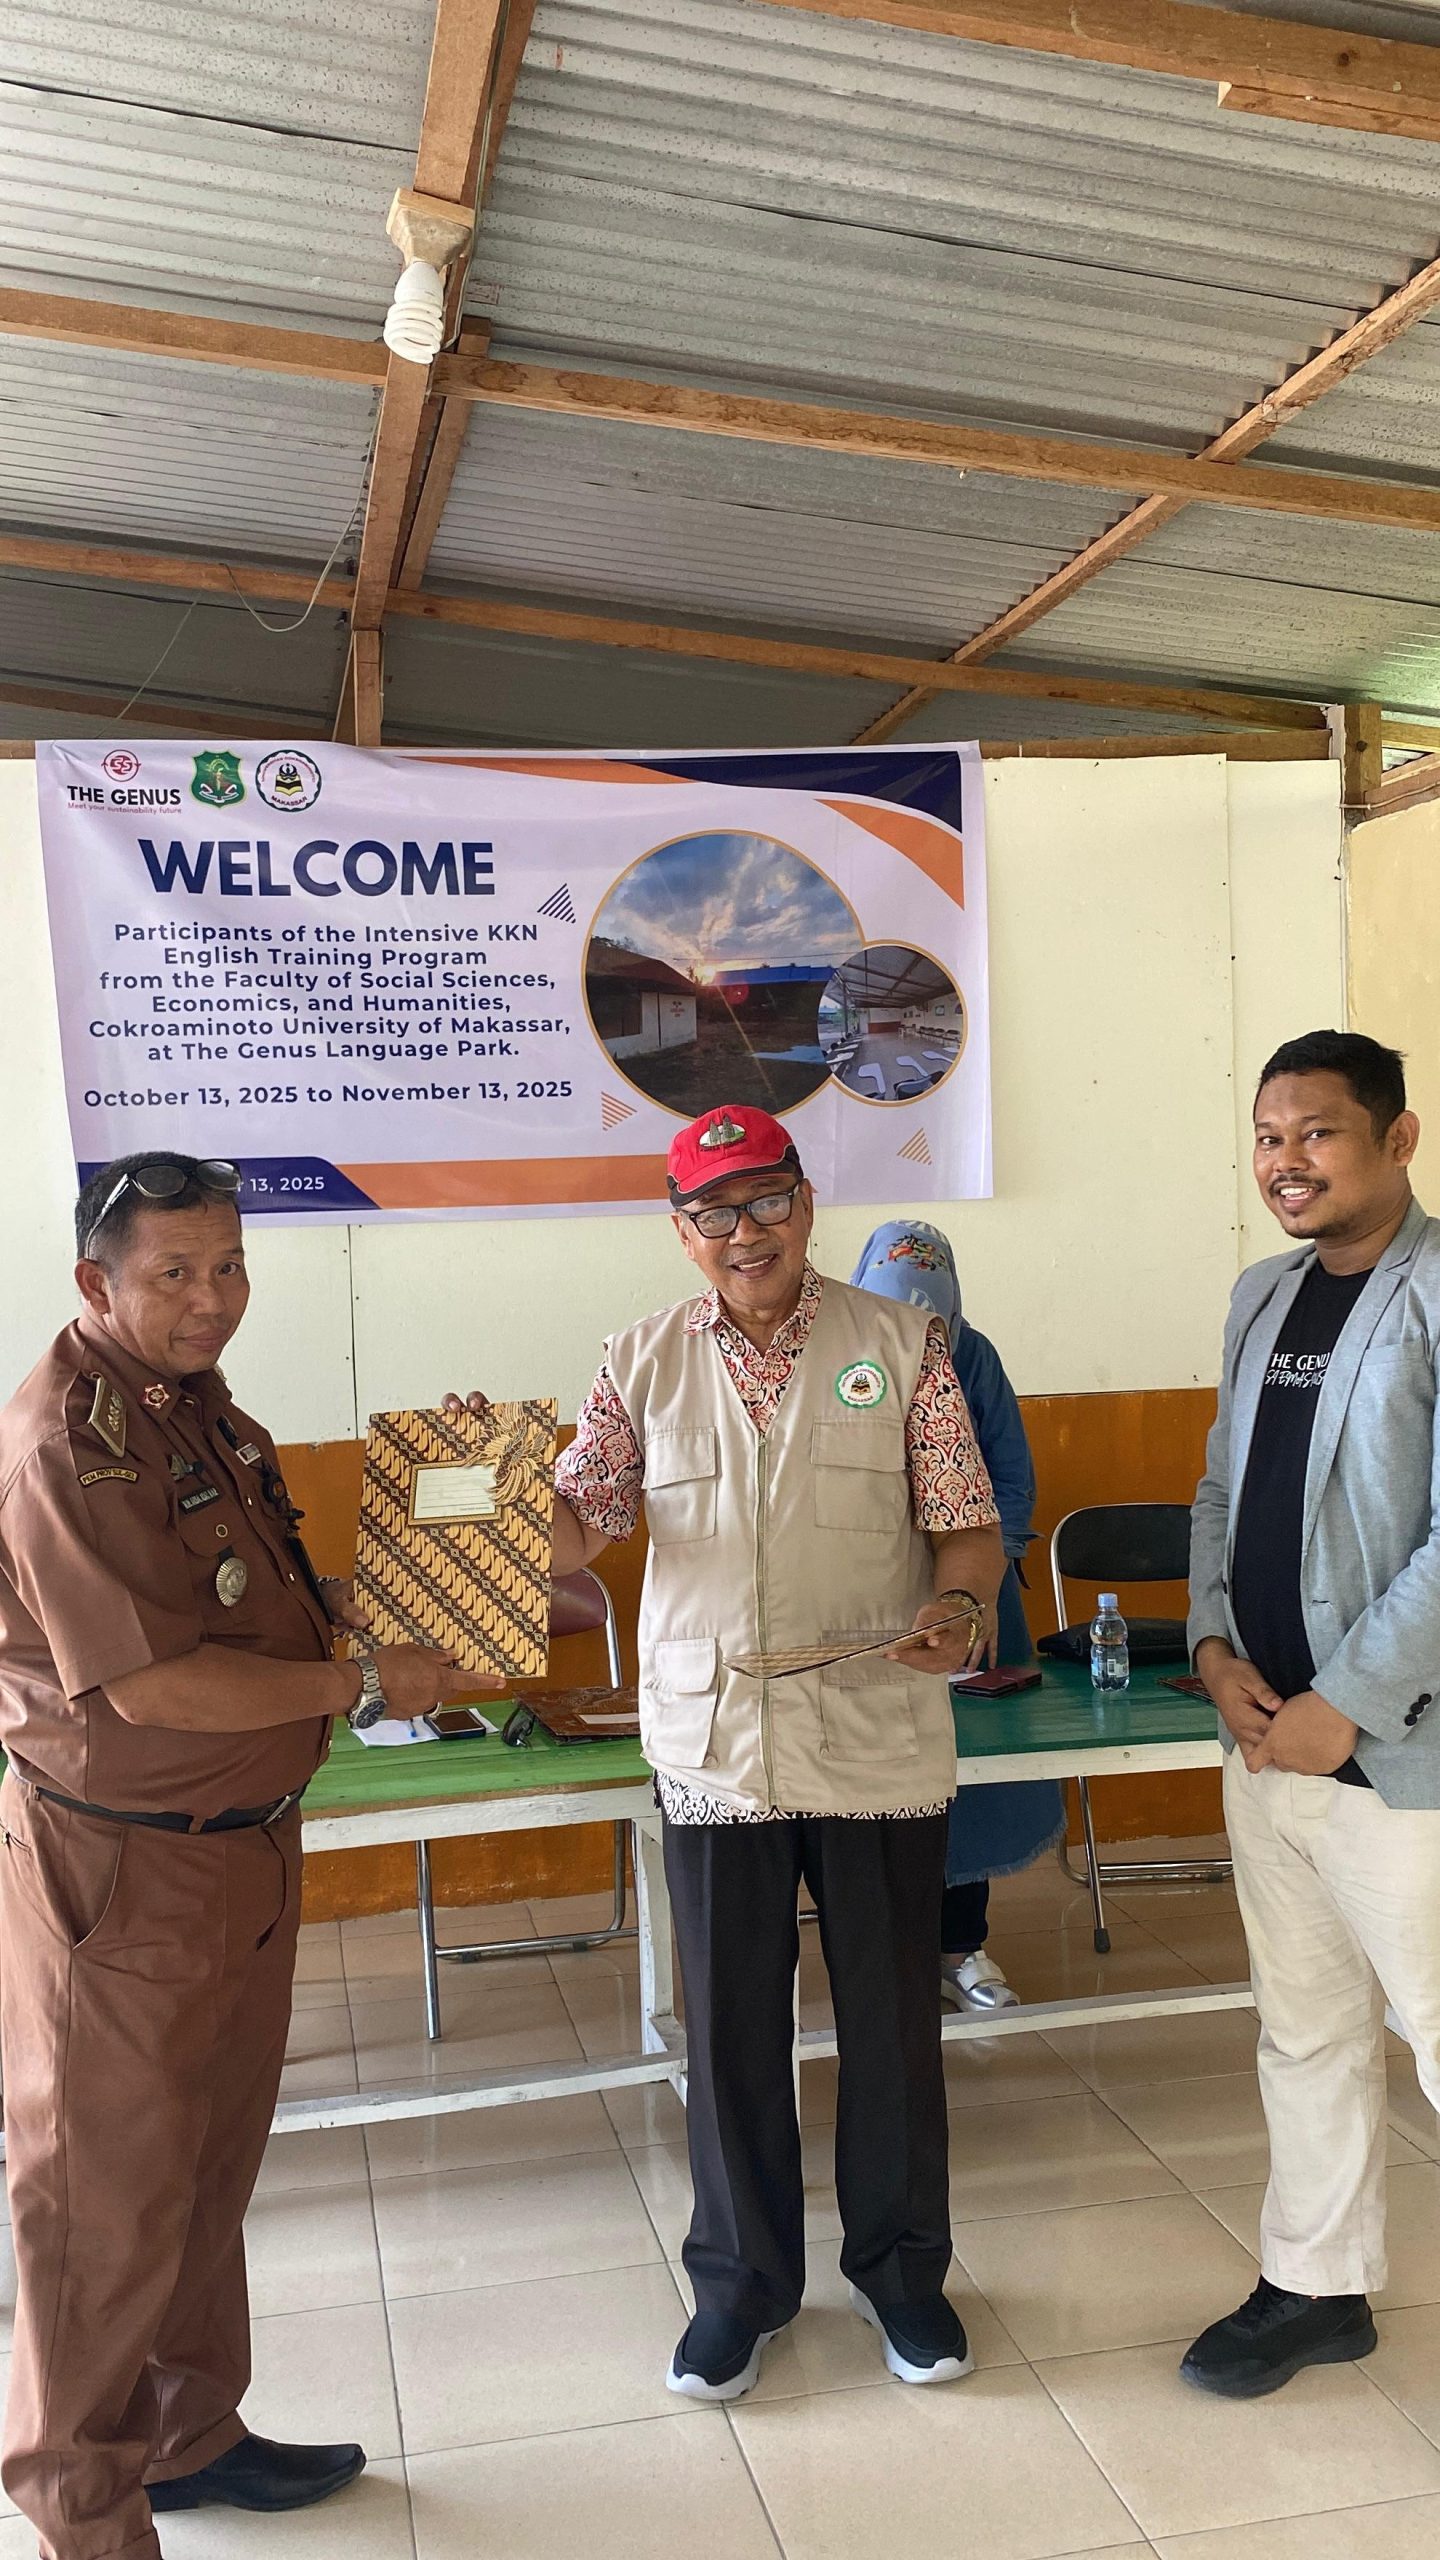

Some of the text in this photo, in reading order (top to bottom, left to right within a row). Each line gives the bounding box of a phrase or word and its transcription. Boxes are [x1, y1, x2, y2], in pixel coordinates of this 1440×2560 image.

[66, 785, 182, 806] THE GENUS
[270, 795, 308, 807] MAKASSAR
[136, 838, 496, 898] WELCOME
[114, 920, 538, 945] Participants of the Intensive KKN
[164, 944, 487, 970] English Training Program
[98, 969, 556, 993] from the Faculty of Social Sciences,
[152, 992, 511, 1015] Economics, and Humanities,
[88, 1015, 571, 1039] Cokroaminoto University of Makassar,
[148, 1038, 520, 1062] at The Genus Language Park.
[83, 1080, 573, 1108] October 13, 2025 to November 13, 2025
[249, 1178, 274, 1194] 13,
[279, 1176, 326, 1192] 2025
[1296, 1352, 1330, 1371] GENU
